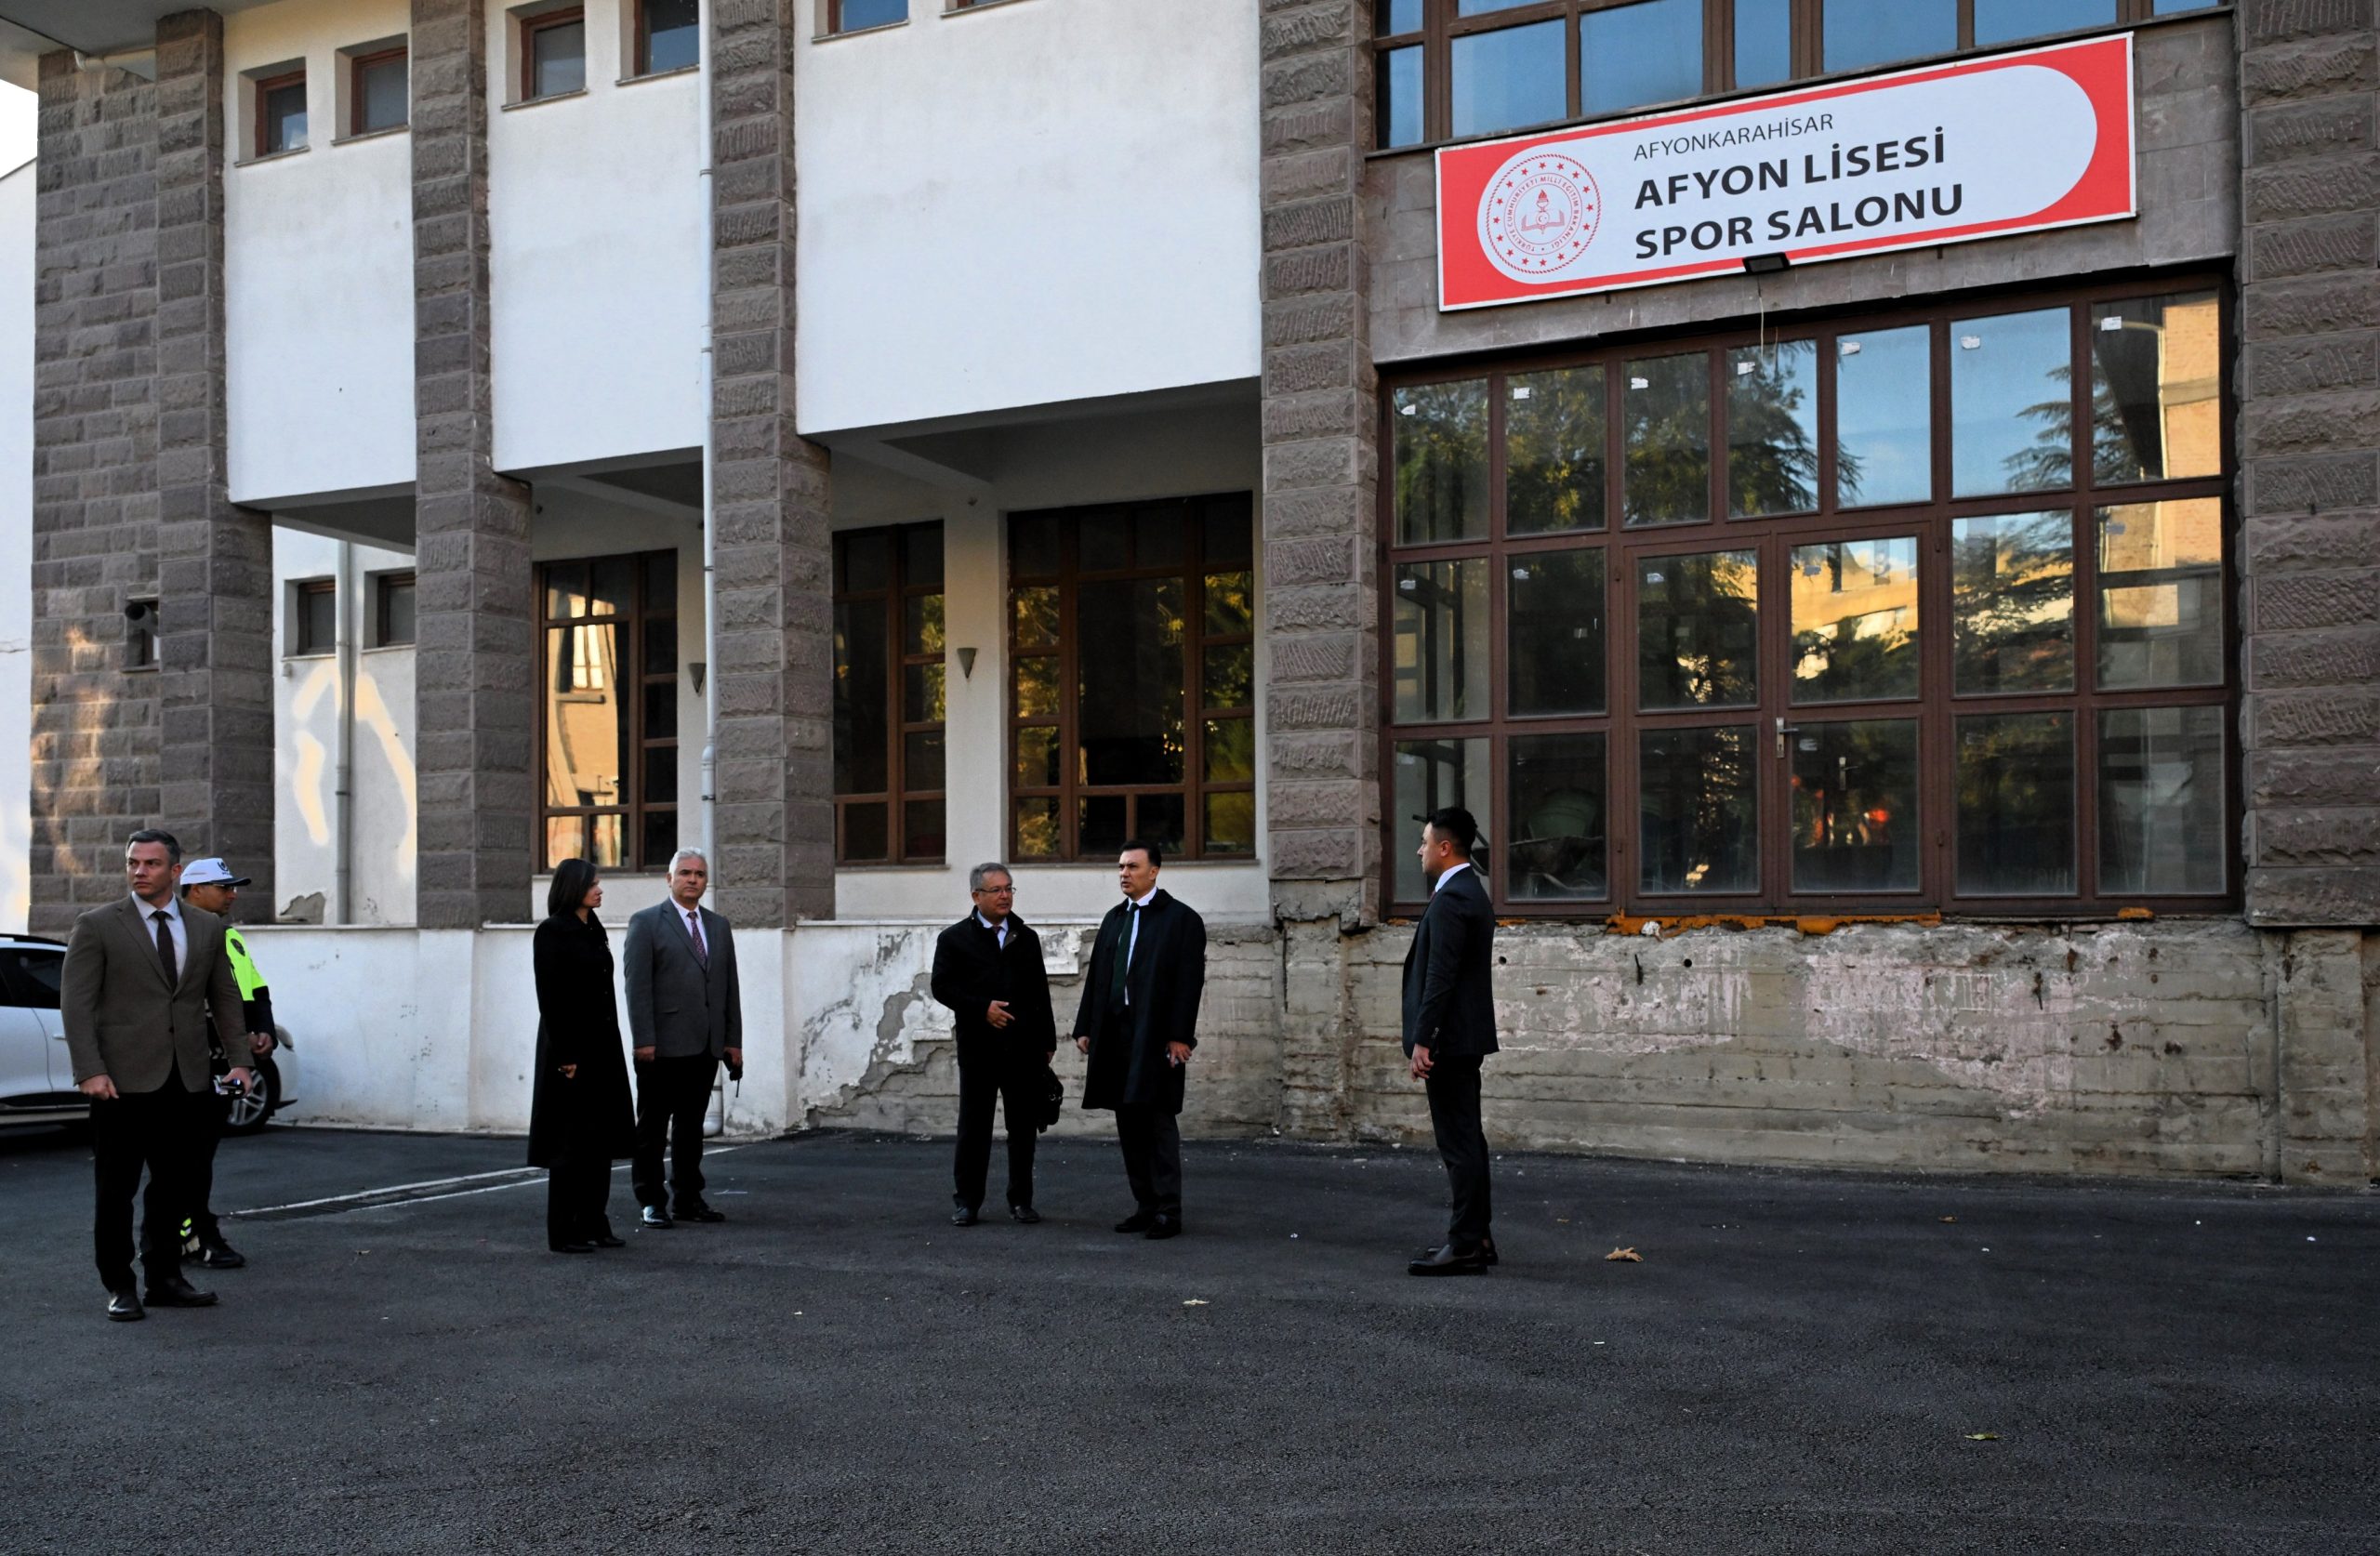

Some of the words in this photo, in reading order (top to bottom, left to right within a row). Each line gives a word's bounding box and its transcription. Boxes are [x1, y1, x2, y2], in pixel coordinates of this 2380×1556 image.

[1633, 113, 1833, 162] AFYONKARAHİSAR
[1634, 158, 1788, 210] AFYON
[1805, 125, 1944, 184] LİSESİ
[1635, 216, 1753, 259] SPOR
[1767, 183, 1963, 241] SALONU
